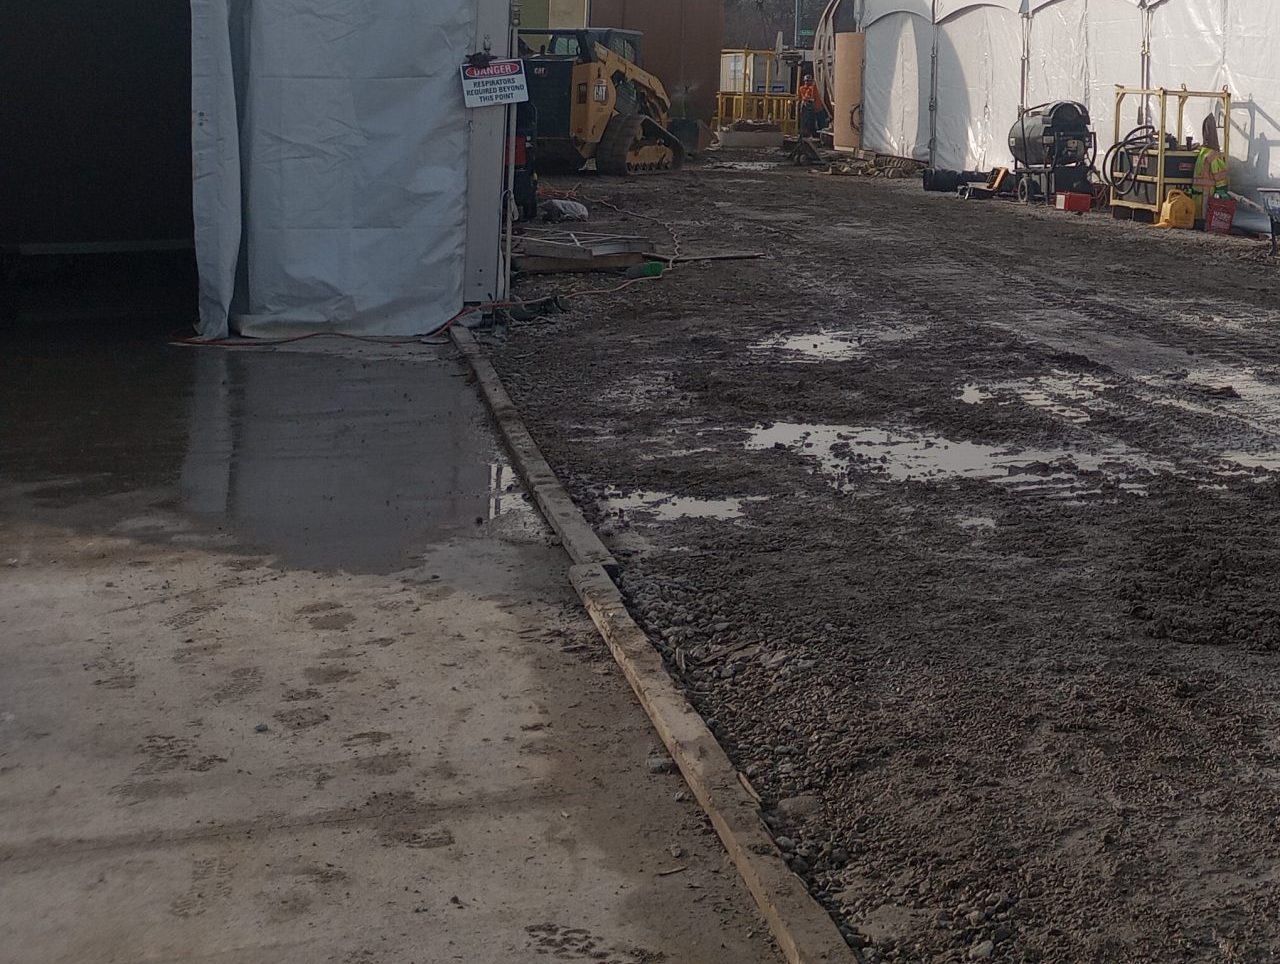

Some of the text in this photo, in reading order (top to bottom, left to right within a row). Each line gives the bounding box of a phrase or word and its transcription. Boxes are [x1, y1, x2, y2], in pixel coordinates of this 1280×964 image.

[473, 64, 512, 76] DANGER
[534, 67, 545, 75] CAT
[473, 78, 516, 88] RESPIRATORS
[466, 84, 525, 96] REQUIRED BEYOND
[594, 85, 606, 101] CAT
[479, 93, 514, 103] THIS POINT
